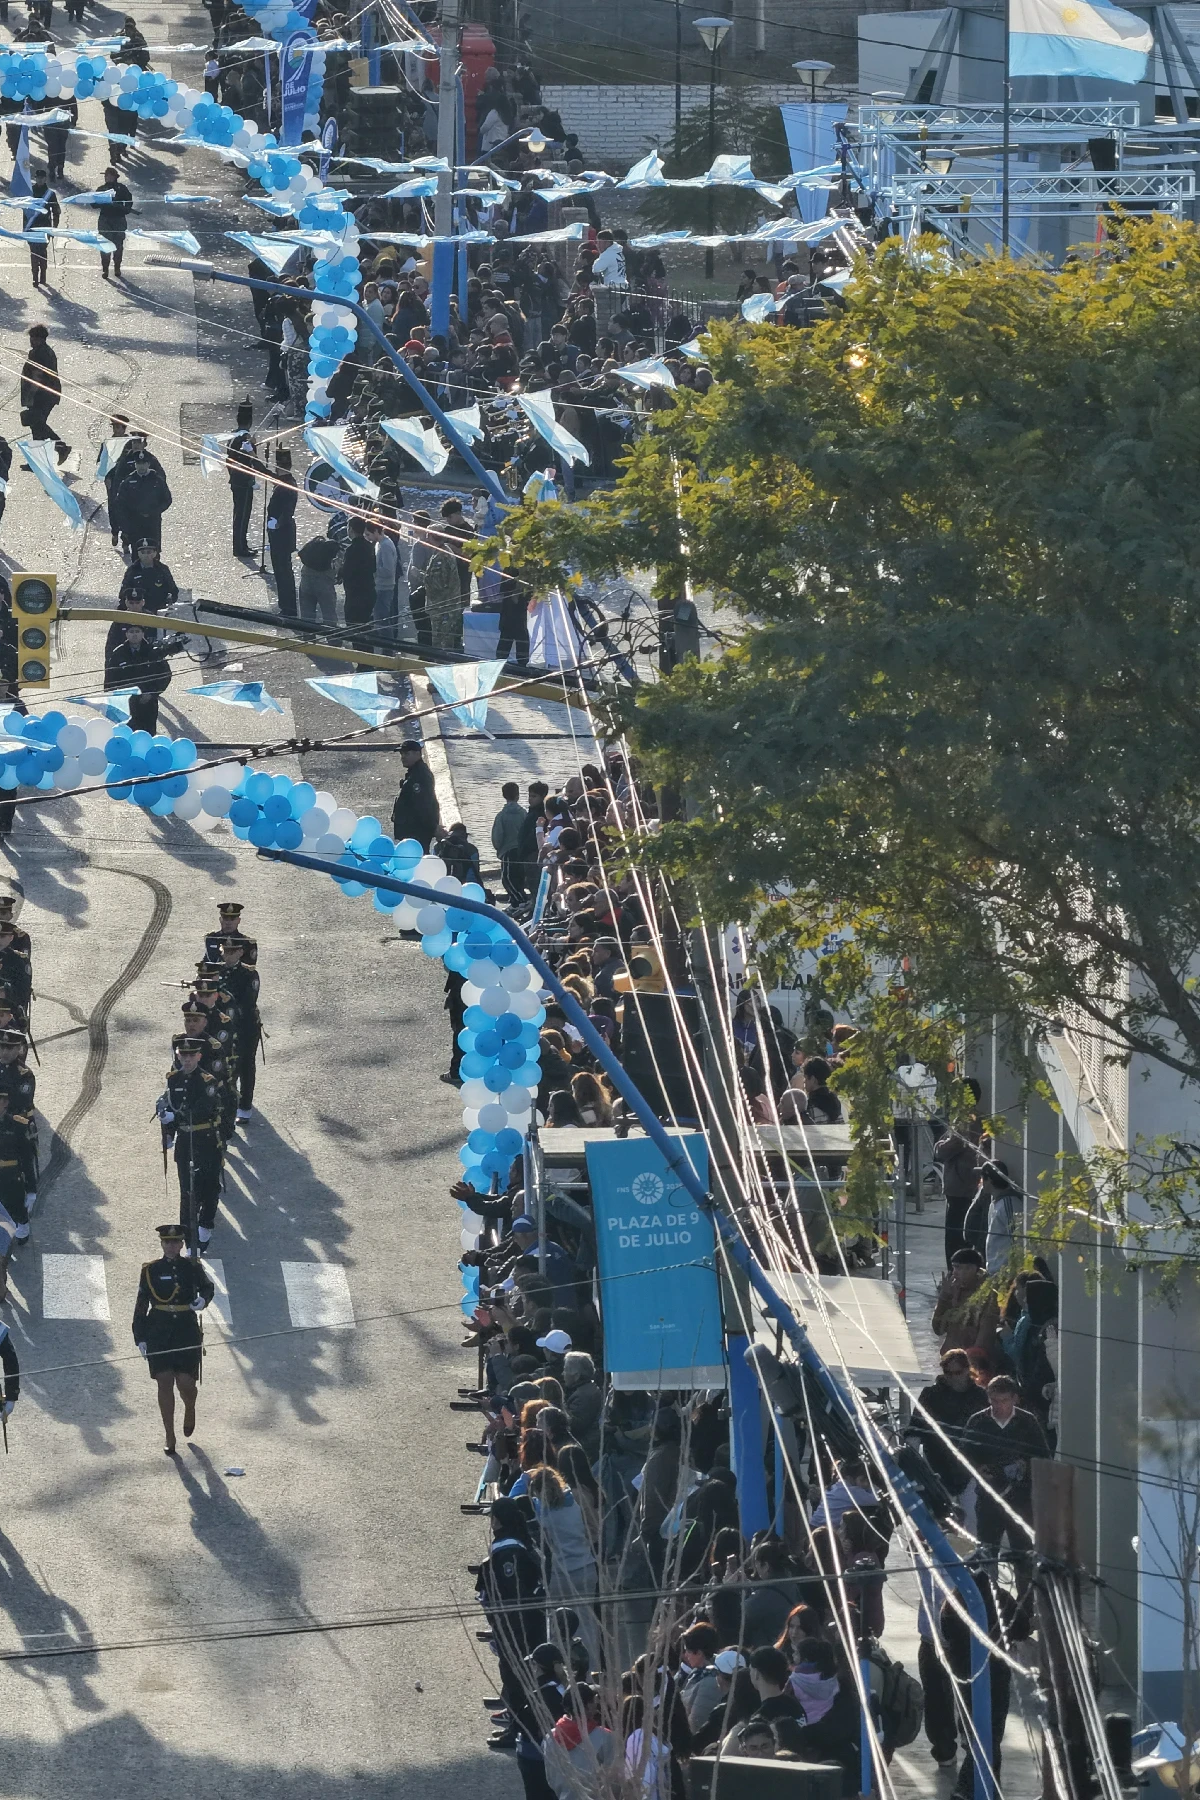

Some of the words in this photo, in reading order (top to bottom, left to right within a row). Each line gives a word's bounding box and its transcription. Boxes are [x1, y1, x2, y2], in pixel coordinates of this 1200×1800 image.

[283, 85, 306, 97] JULIO
[607, 1214, 662, 1231] PLAZA
[666, 1213, 687, 1227] DE
[690, 1211, 700, 1225] 9
[619, 1234, 640, 1248] DE
[644, 1230, 692, 1247] JULIO
